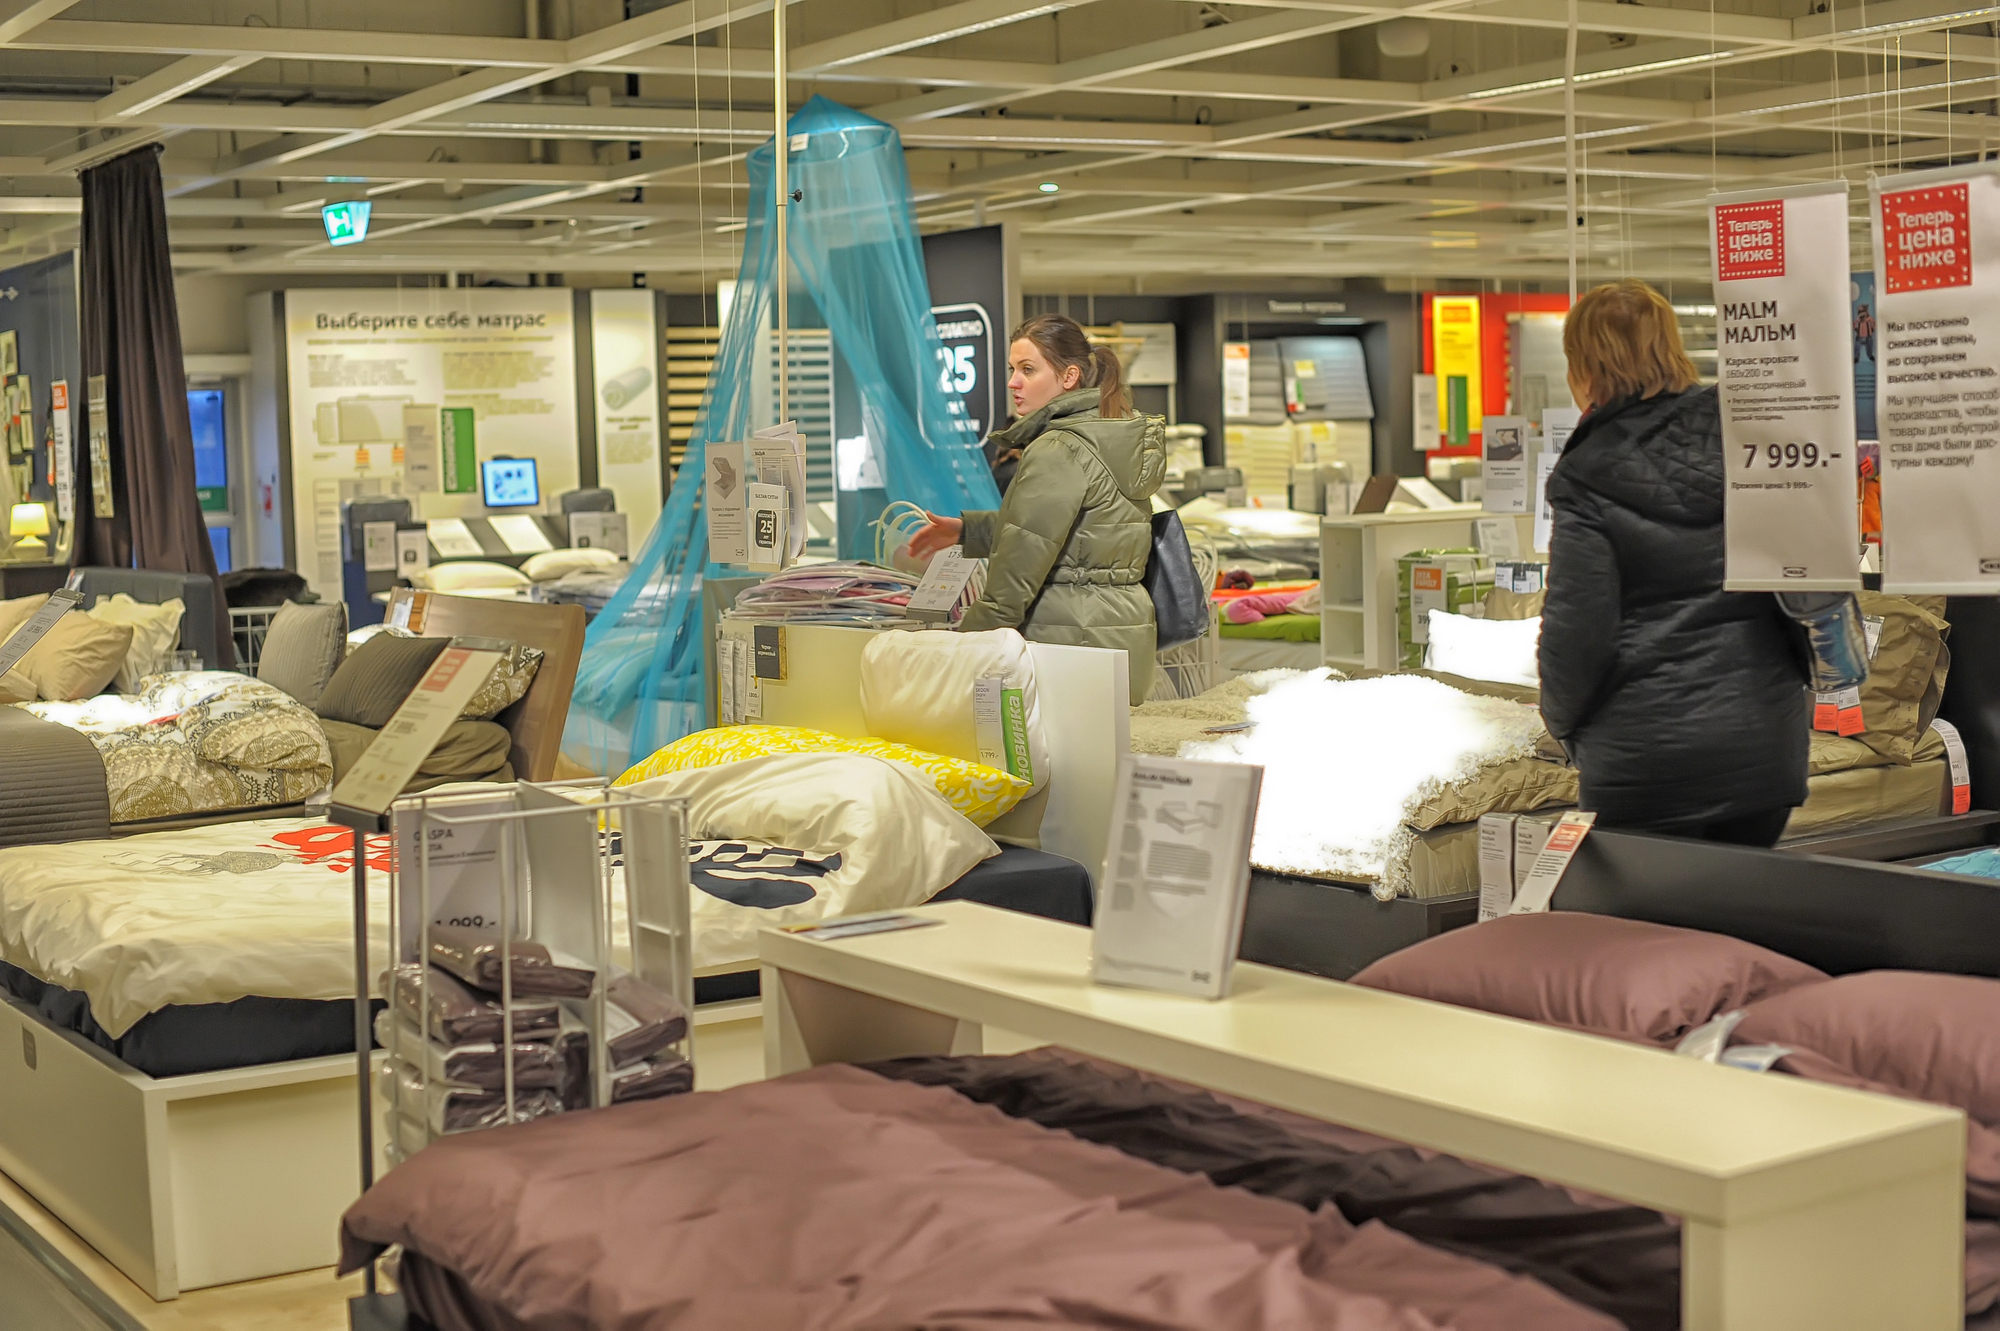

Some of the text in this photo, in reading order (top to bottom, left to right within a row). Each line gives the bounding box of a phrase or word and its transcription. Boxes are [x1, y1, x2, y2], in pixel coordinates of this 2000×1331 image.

[1728, 220, 1773, 233] Теперь
[1897, 210, 1955, 228] Теперь
[1729, 232, 1773, 250] цена
[1899, 227, 1955, 252] цена
[1729, 248, 1774, 263] ниже
[1900, 249, 1956, 270] ниже
[1723, 300, 1777, 321] MALM
[316, 311, 547, 332] Выберите себе матрас
[1887, 317, 1970, 332] Мы постоянно
[1725, 323, 1796, 344] МАЛЬМ
[1887, 337, 1938, 350] снижаем
[1725, 356, 1799, 367] Каркас кровати
[1903, 352, 1967, 367] сохраняем
[935, 345, 976, 394] 25
[1887, 371, 1937, 384] высокое
[1907, 393, 1959, 406] улучшаем
[1889, 426, 1926, 437] товары
[1929, 425, 1948, 436] для
[1743, 442, 1842, 469] 7 999.-
[760, 519, 773, 534] 25
[413, 829, 453, 842] GSPA
